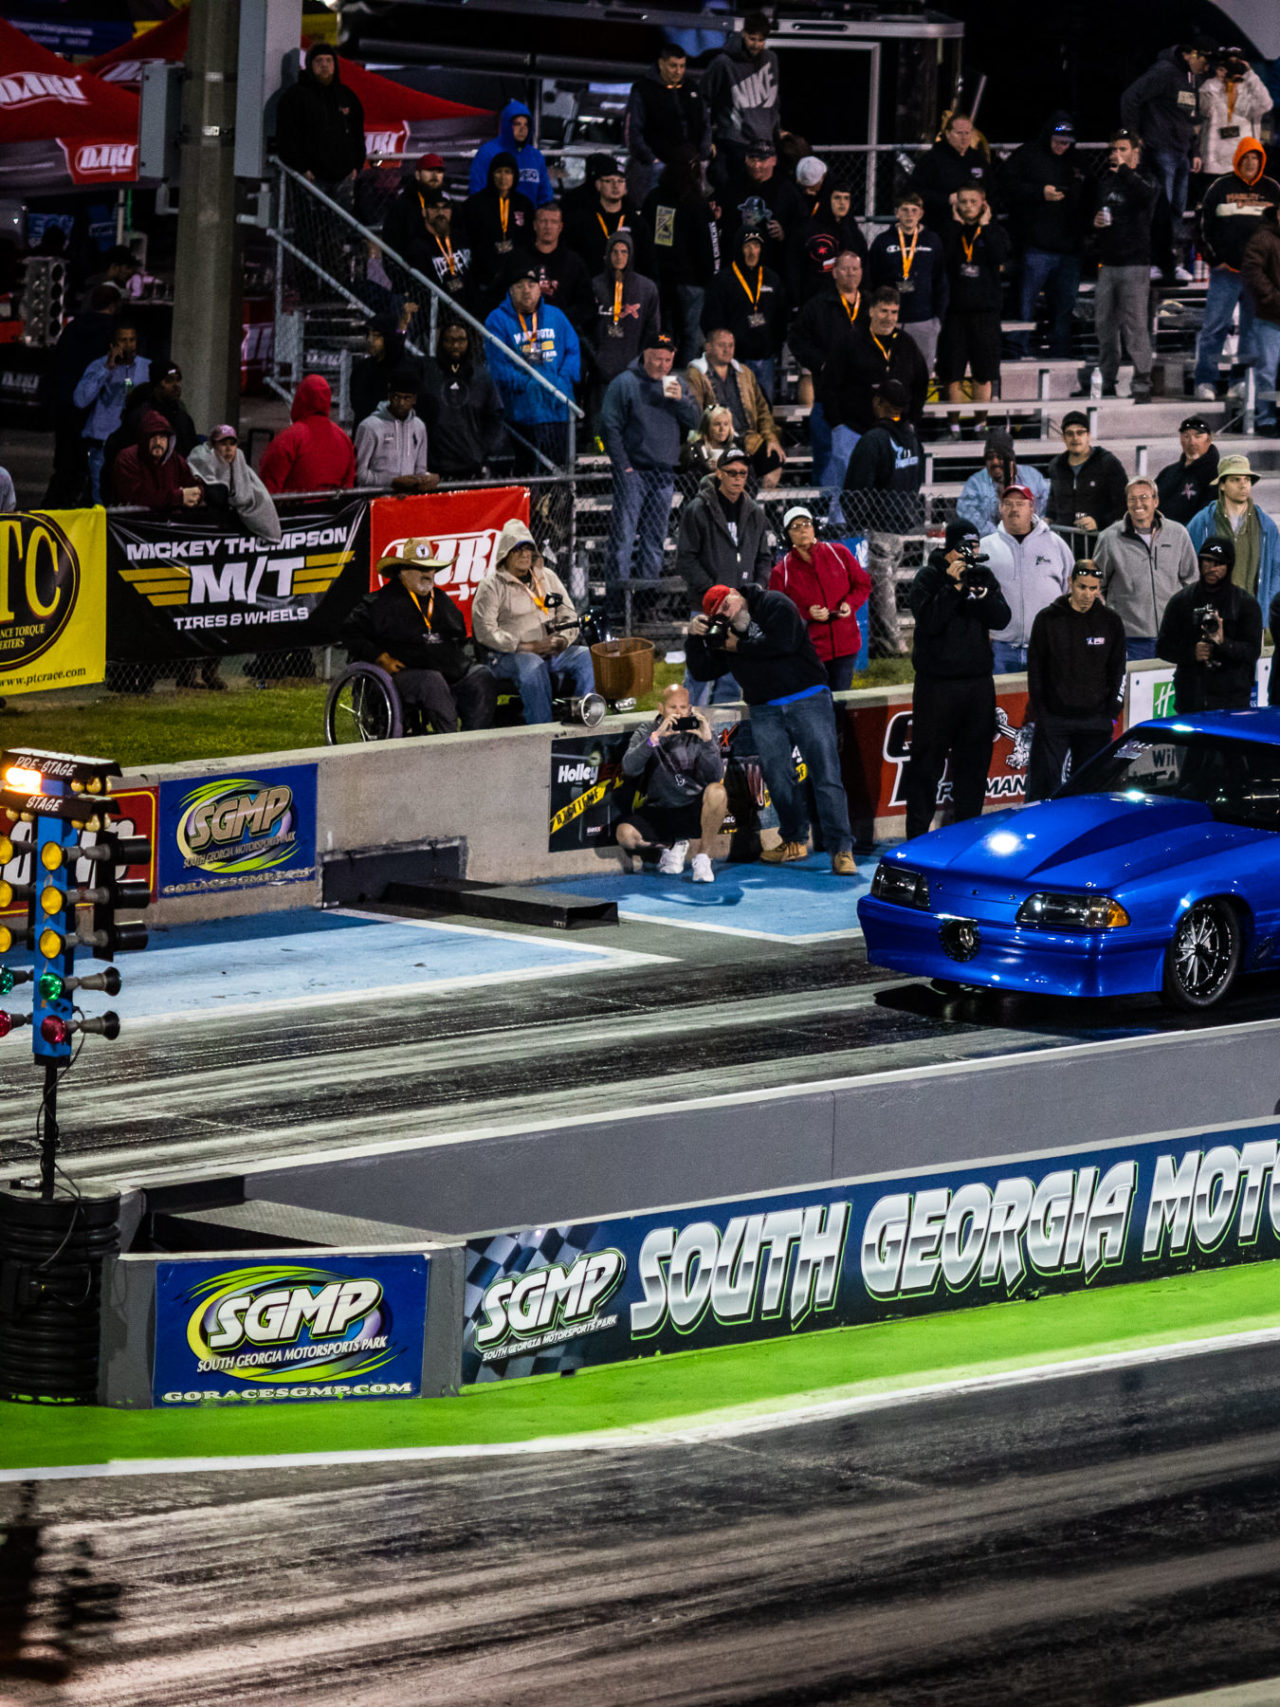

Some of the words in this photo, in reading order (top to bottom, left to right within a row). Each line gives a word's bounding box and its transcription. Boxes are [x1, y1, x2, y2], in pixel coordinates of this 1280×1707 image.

[731, 61, 779, 108] NIKE
[0, 520, 61, 621] TC
[127, 541, 221, 561] MICKEY
[190, 555, 305, 604] M/T
[15, 623, 46, 637] TORQUE
[174, 613, 228, 631] TIRES
[229, 613, 242, 626] &
[243, 606, 309, 625] WHEELS
[15, 756, 77, 777] PRE-STAGE
[557, 762, 598, 783] Holley
[26, 796, 62, 812] STAGE
[190, 785, 293, 851] SGMP
[630, 1201, 852, 1341] SOUTH
[861, 1160, 1139, 1297] GEORGIA
[208, 1279, 383, 1350] SGMP
[476, 1250, 622, 1347] SGMP
[197, 1356, 234, 1373] SOUTH
[236, 1350, 283, 1369] GEORGIA
[283, 1340, 360, 1362] MOTORSPORTS
[360, 1335, 388, 1350] PARK
[482, 1347, 507, 1362] SOUTH
[507, 1336, 542, 1357] GEORGIA
[542, 1321, 597, 1347] MOTORSPORTS
[596, 1313, 618, 1332] PARK
[162, 1382, 412, 1403] GORACESGMP.COM
